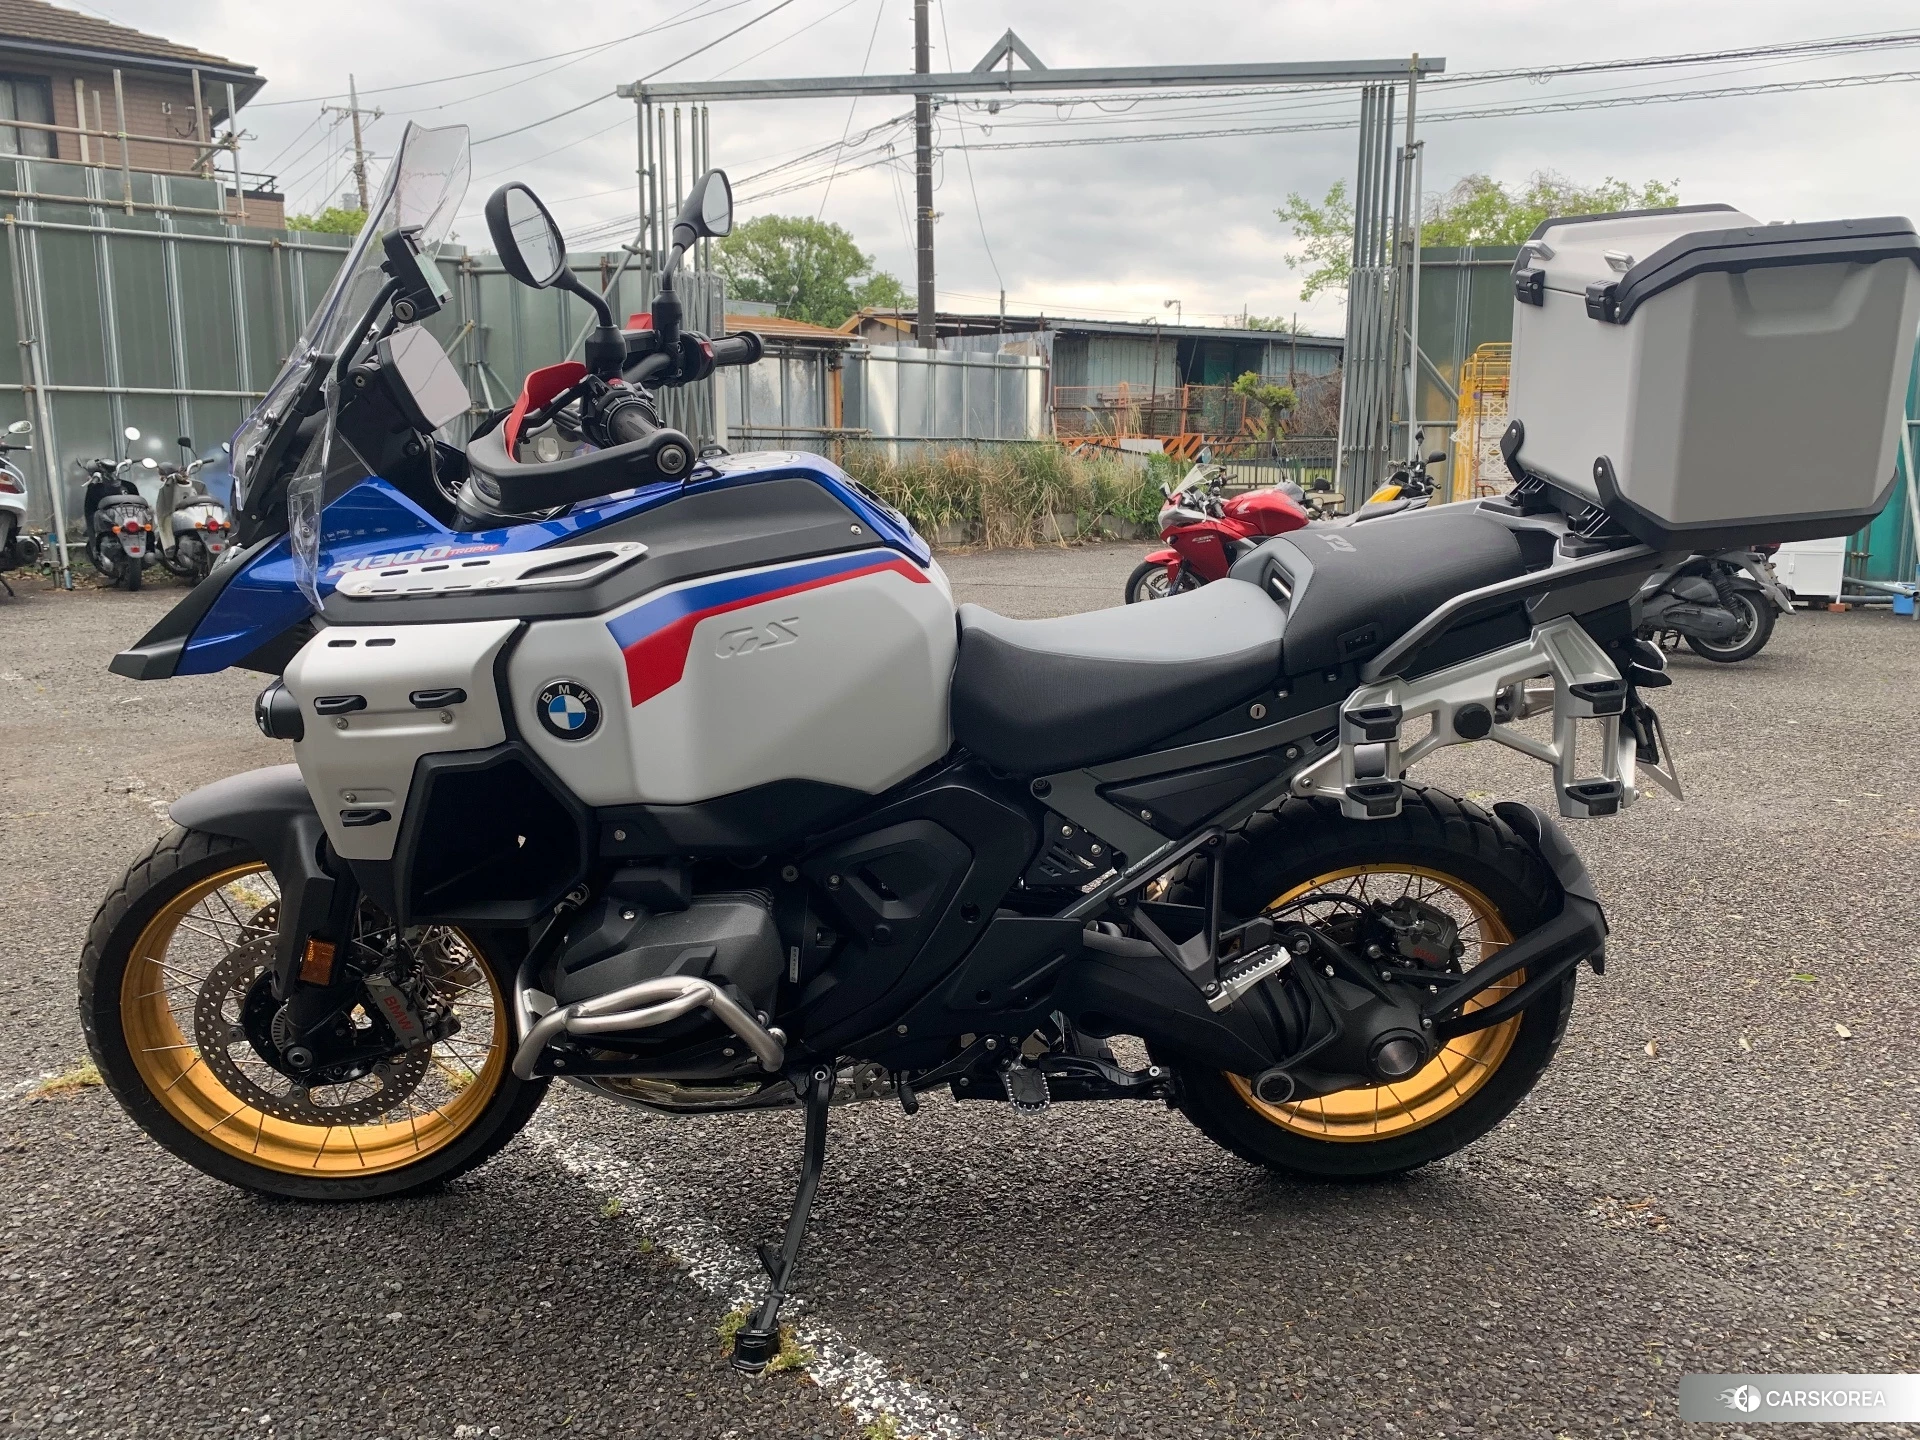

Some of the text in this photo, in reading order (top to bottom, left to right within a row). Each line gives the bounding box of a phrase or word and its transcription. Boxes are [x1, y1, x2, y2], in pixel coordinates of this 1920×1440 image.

[326, 544, 499, 577] R1300 TROPHY
[715, 616, 799, 659] GS
[541, 684, 592, 704] BMW
[384, 995, 414, 1031] BMW
